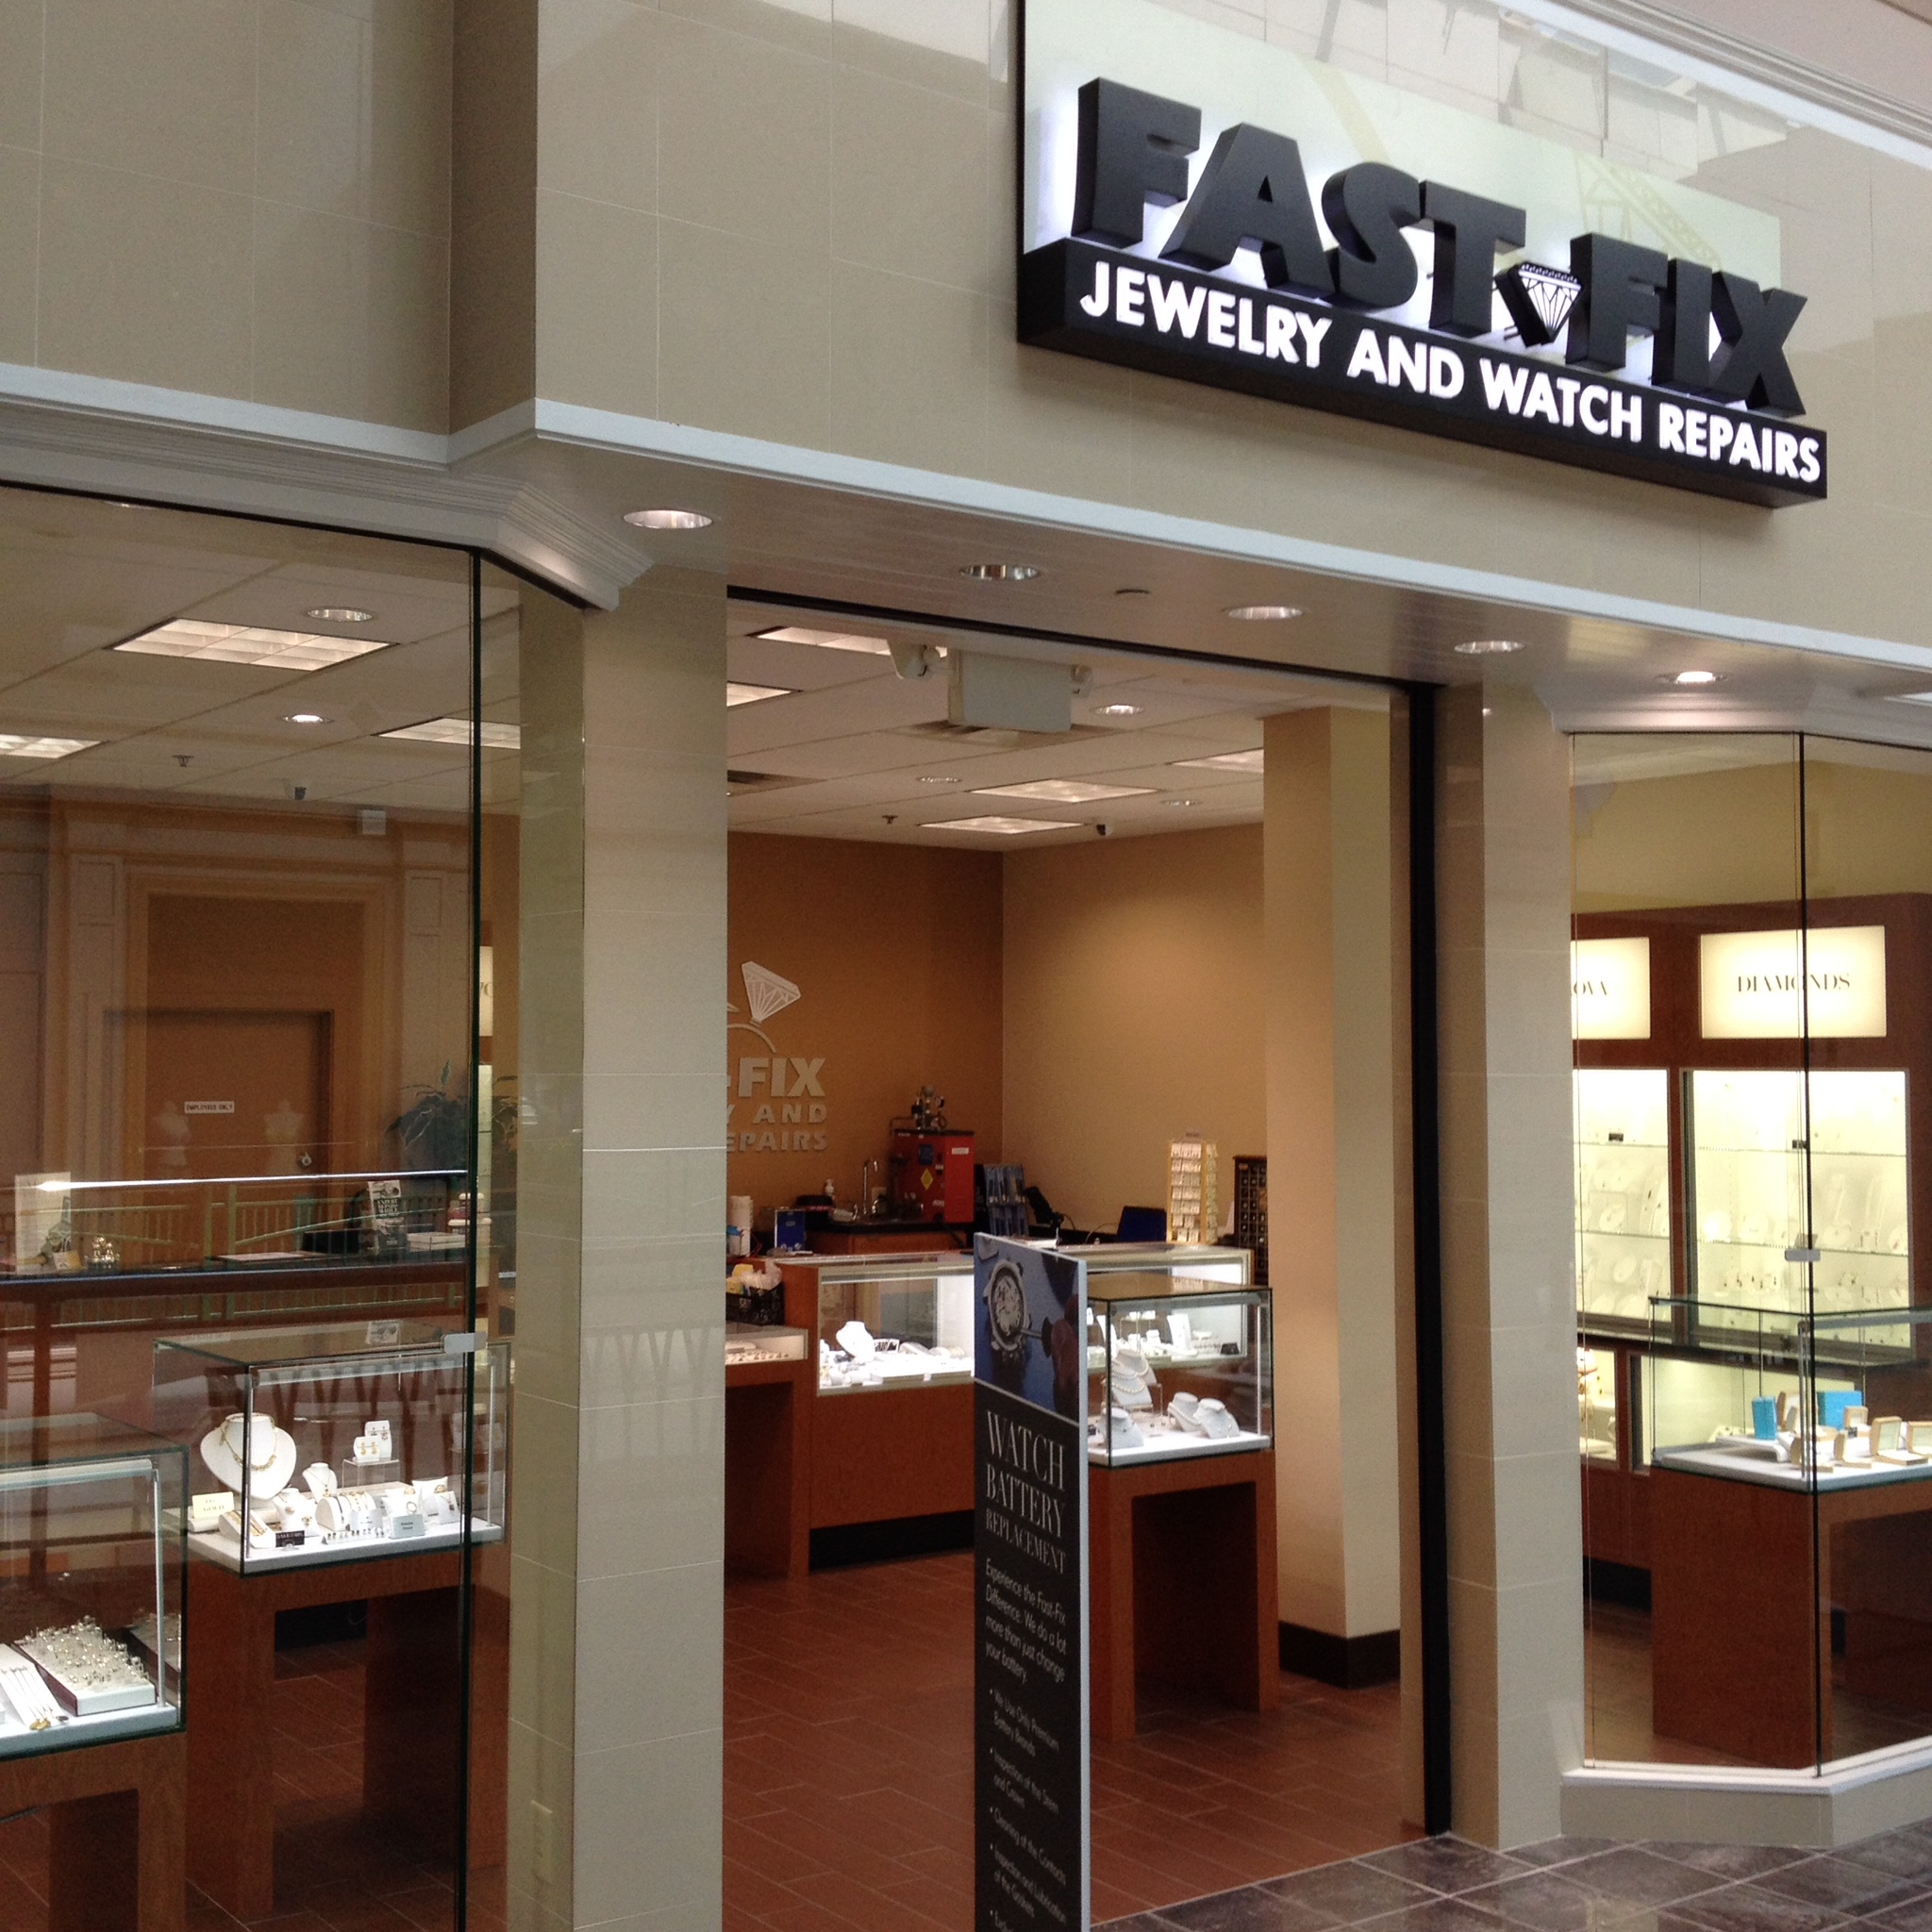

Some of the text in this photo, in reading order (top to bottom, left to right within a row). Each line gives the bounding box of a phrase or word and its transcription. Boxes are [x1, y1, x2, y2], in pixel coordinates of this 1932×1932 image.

[1072, 77, 1808, 418] FAST FIX
[1079, 261, 1822, 483] JEWELRY AND WATCH REPAIRS
[1738, 973, 1851, 992] DIAMONDS
[752, 1104, 828, 1124] AND
[988, 1409, 1066, 1491] WATCH
[987, 1463, 1066, 1539] BATTERY
[986, 1507, 1066, 1574] REPLACEMENT
[986, 1557, 1023, 1597] Experience
[1024, 1585, 1036, 1607] the
[986, 1615, 1065, 1683] more than just change
[986, 1641, 1002, 1661] your
[1024, 1609, 1037, 1634] We
[1038, 1621, 1048, 1642] do
[1049, 1632, 1055, 1647] a
[1057, 1631, 1066, 1656] lot
